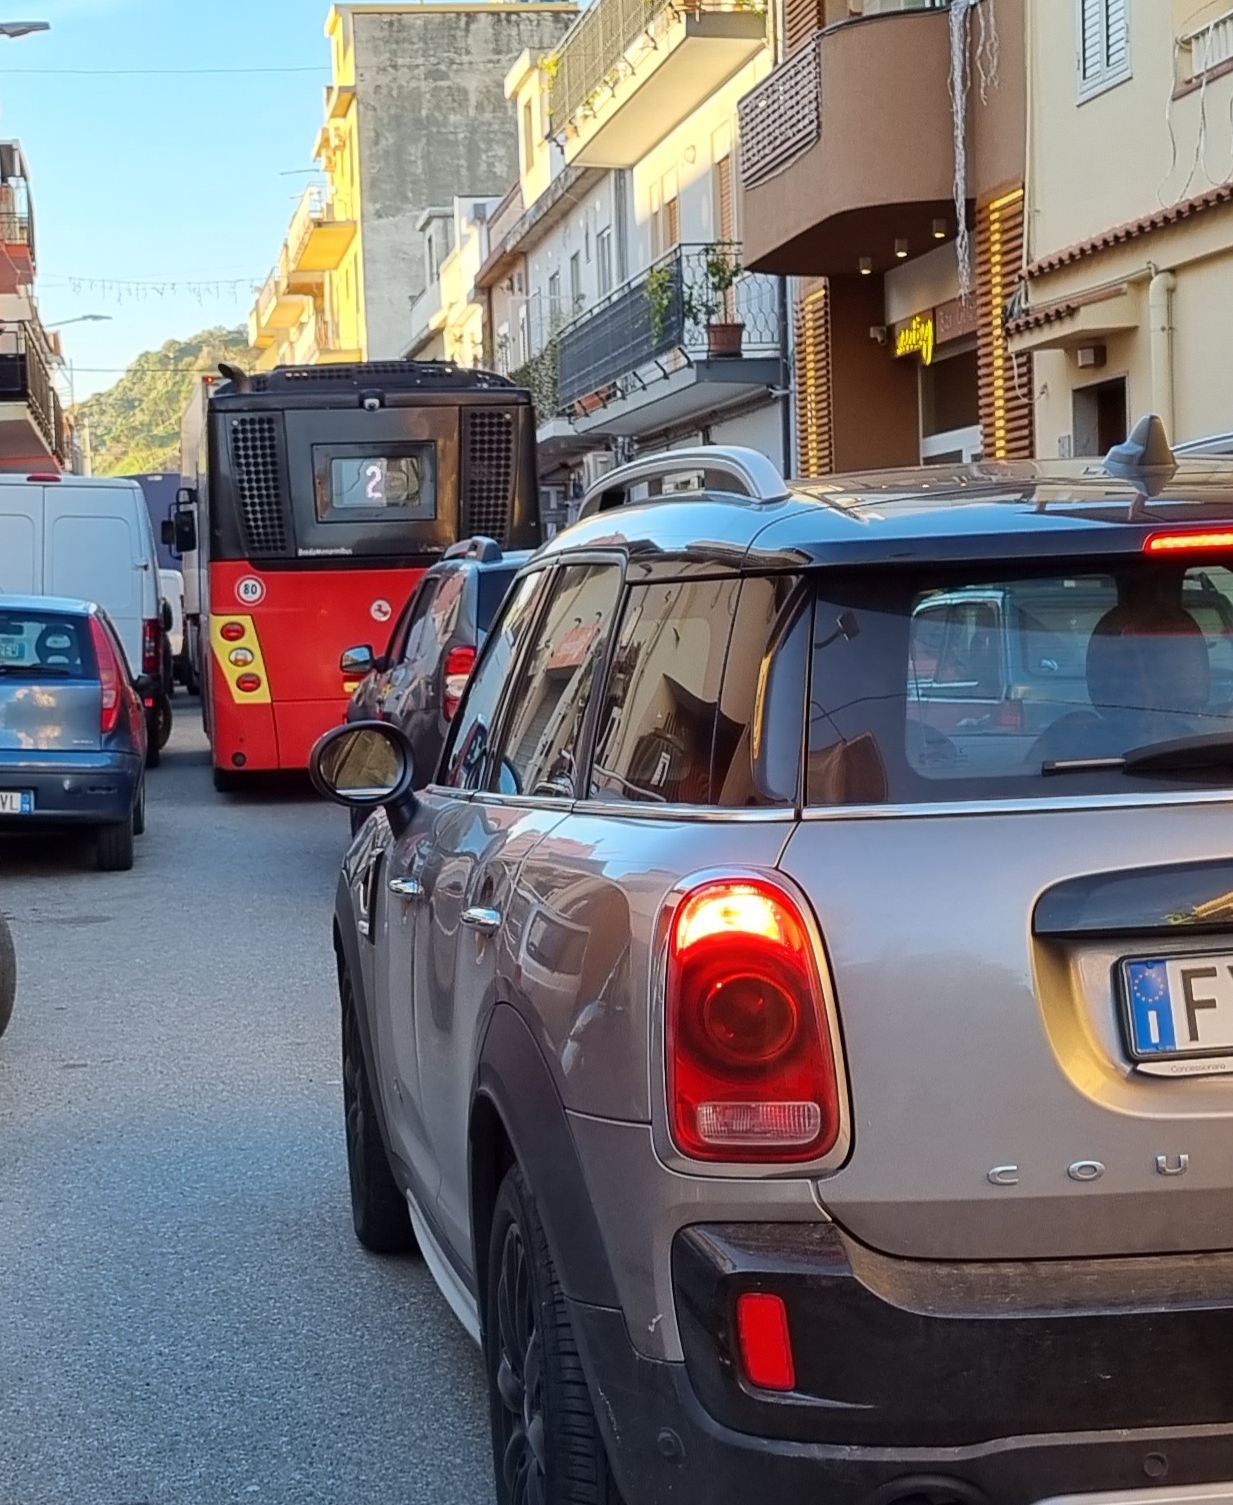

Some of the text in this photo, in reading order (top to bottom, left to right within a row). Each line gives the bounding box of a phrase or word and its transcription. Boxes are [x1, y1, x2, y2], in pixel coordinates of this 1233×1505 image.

[366, 465, 382, 499] 2
[243, 583, 258, 595] 80
[1170, 1063, 1227, 1074] Concessionaria
